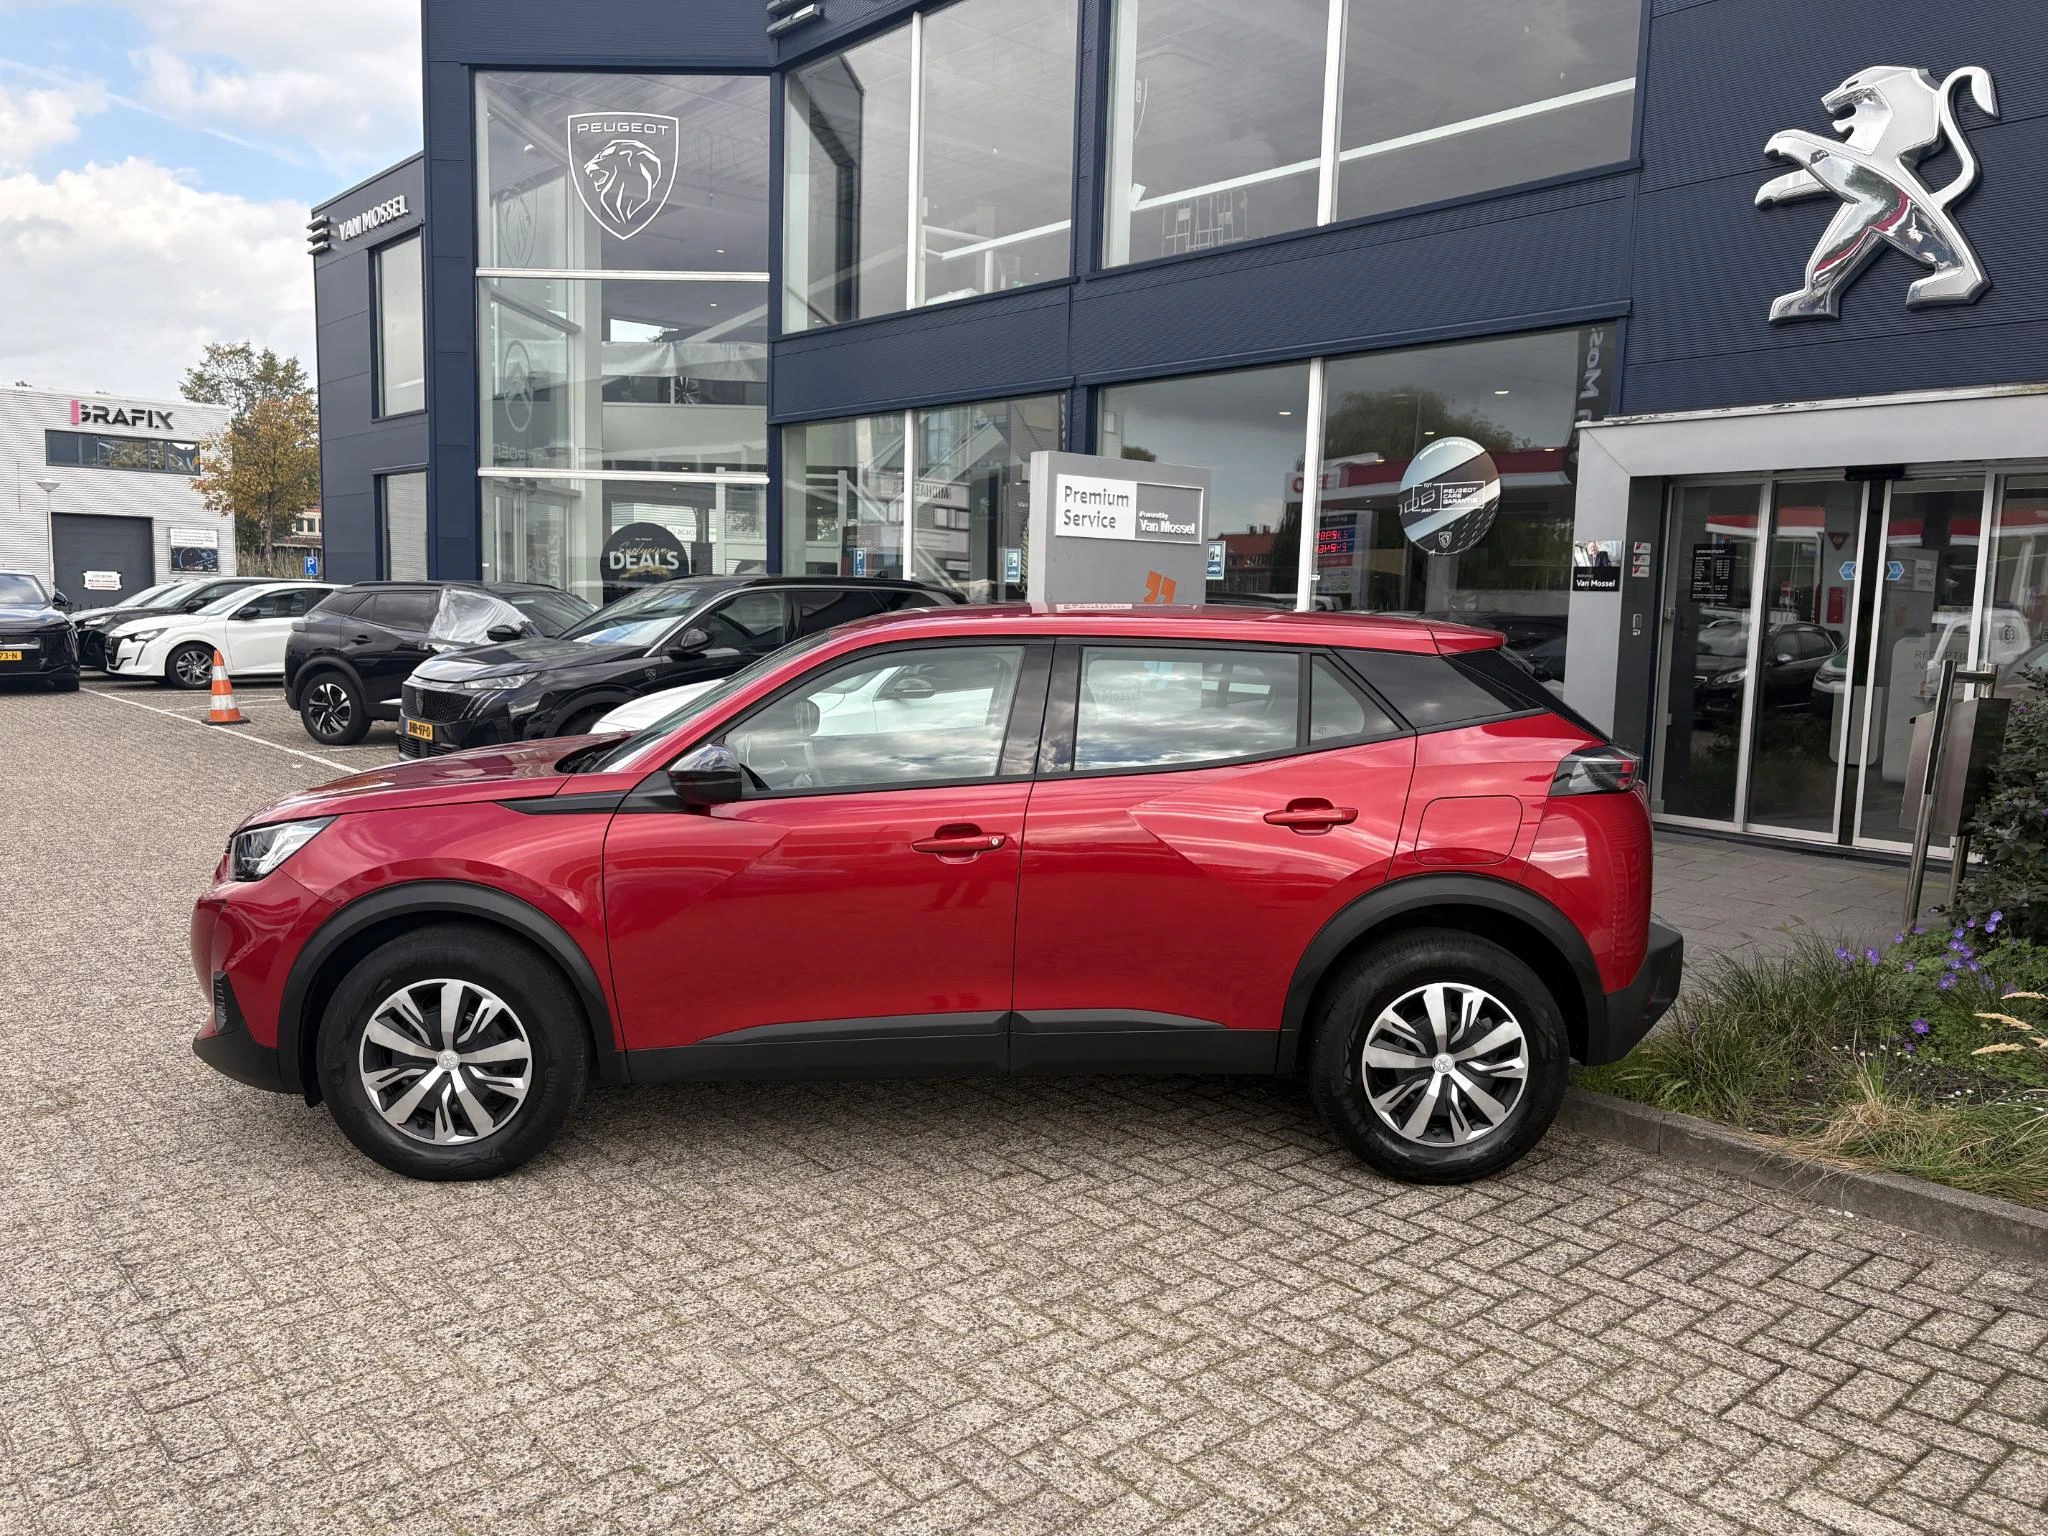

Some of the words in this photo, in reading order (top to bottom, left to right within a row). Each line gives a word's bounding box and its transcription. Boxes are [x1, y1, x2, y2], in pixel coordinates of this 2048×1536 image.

[577, 122, 669, 135] PEUGEOT
[338, 214, 362, 241] VAN
[362, 194, 409, 229] MOSSEL
[71, 400, 175, 430] GRAFIX
[1064, 485, 1129, 507] Premium
[1063, 508, 1116, 529] Service
[1139, 518, 1159, 532] Van
[1160, 520, 1195, 535] Mossel
[308, 558, 315, 567] P
[609, 551, 680, 570] DEALS
[856, 551, 863, 562] P
[1576, 579, 1590, 587] Van
[1590, 579, 1616, 588] Mossel
[0, 652, 18, 660] 73-N
